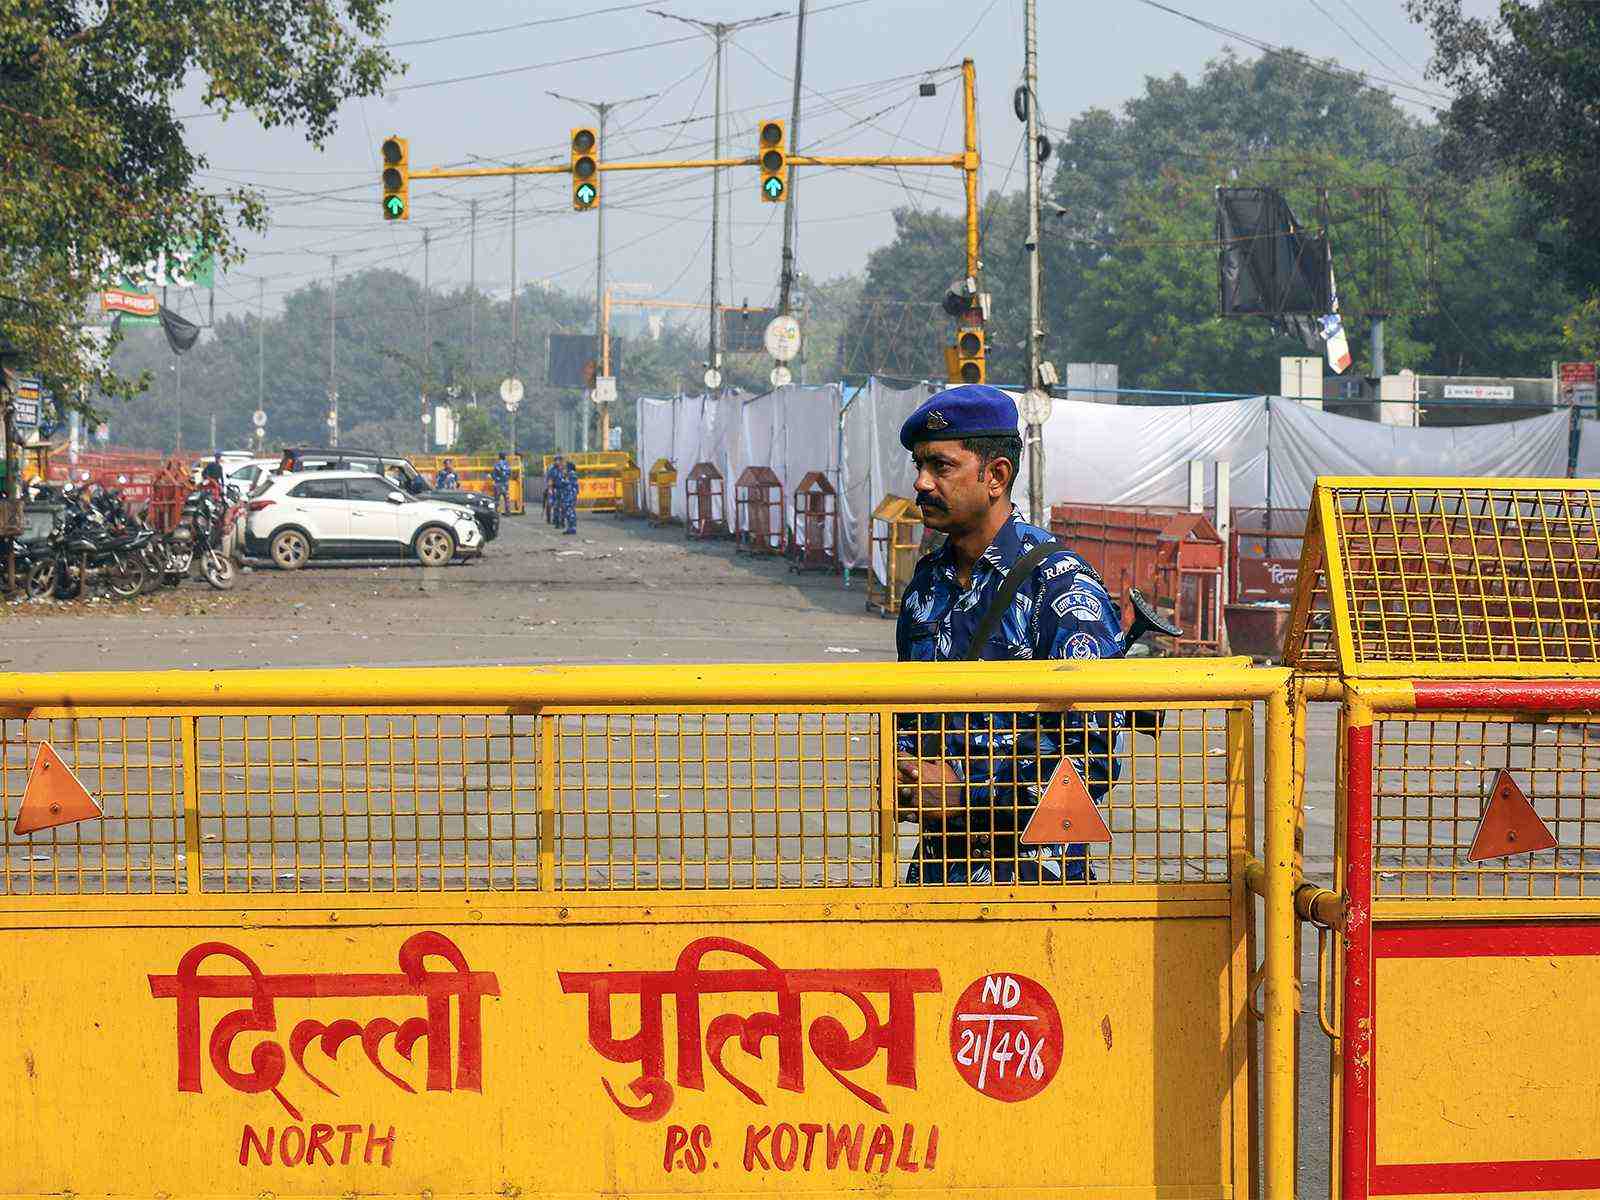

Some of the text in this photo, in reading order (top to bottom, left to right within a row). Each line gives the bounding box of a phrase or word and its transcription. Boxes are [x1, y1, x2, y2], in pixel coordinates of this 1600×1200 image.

[982, 975, 1022, 1010] ND
[148, 931, 942, 1123] दिल्ली पुलिस
[238, 1124, 396, 1168] NORTH
[663, 1123, 939, 1173] P.S. KOTWALI
